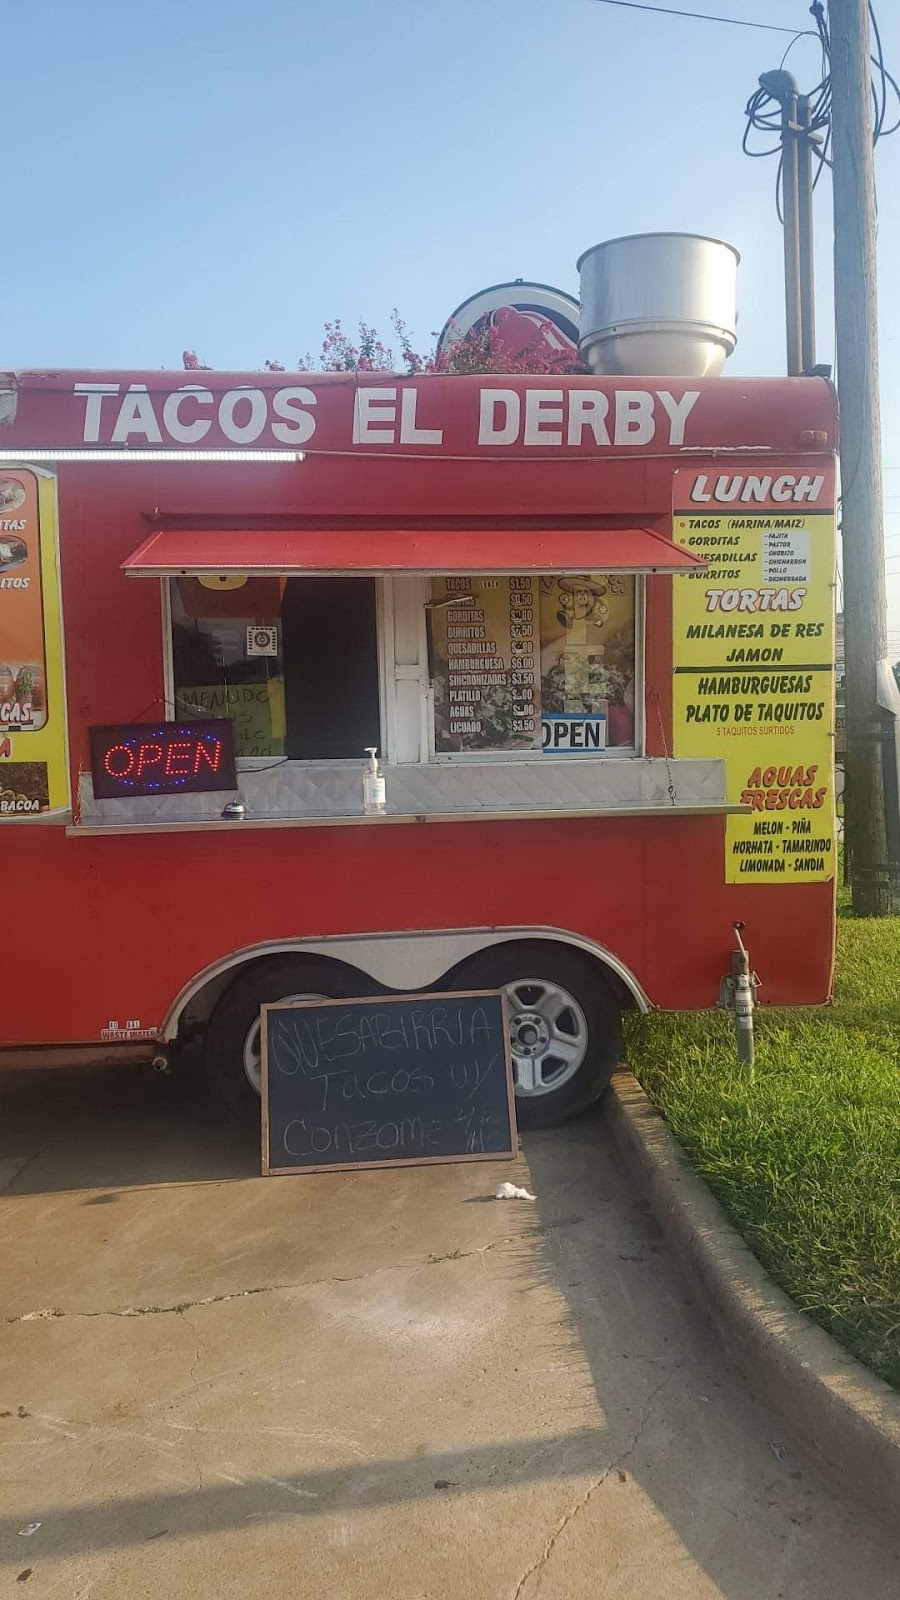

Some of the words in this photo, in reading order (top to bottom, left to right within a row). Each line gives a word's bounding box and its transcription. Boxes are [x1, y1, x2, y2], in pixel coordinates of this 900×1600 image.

[73, 382, 317, 445] TACOS
[352, 386, 443, 445] EL
[478, 388, 701, 446] DERBY
[690, 474, 825, 502] LUNCH
[688, 519, 721, 529] TACOS
[727, 518, 806, 530] (HARINA/MAIZ)
[688, 536, 741, 546] GORDITAS
[446, 576, 472, 590] TACOS
[509, 576, 532, 591] $1.50
[705, 588, 807, 613] TORTAS
[447, 610, 484, 622] GORDITAS
[447, 626, 485, 639] BURRITOS
[686, 624, 764, 639] MILANESA
[770, 624, 791, 638] DE
[795, 622, 825, 638] RES
[447, 642, 496, 655] QUESADILLAS
[726, 648, 784, 662] JAMON
[448, 658, 505, 670] HAMBURGUESA
[511, 657, 534, 669] $6.00
[449, 674, 507, 686] SINCRONIZADAS
[511, 673, 534, 685] $3.50
[698, 675, 813, 695] HAMBURGUESAS
[449, 690, 481, 702] PLATILLO
[450, 705, 475, 717] AGUAS
[686, 704, 730, 723] PLATO
[734, 703, 754, 722] DE
[757, 702, 825, 723] TAQUITOS
[450, 720, 481, 733] LICUADO
[512, 720, 535, 733] $3.50
[716, 728, 721, 736] 5
[722, 727, 757, 736] TAQUITOS
[759, 725, 795, 735] SURTIDOS
[541, 722, 600, 748] OPEN
[104, 741, 222, 777] OPEN
[747, 765, 818, 788] AGUAS
[740, 787, 827, 812] FRESCAS
[753, 821, 783, 835] MELON
[792, 817, 811, 834] PIÑA
[733, 841, 773, 855] HORHATA
[782, 839, 832, 854] TAMARINDO
[740, 859, 785, 872] LIMONADA
[794, 857, 825, 872] SANDIA
